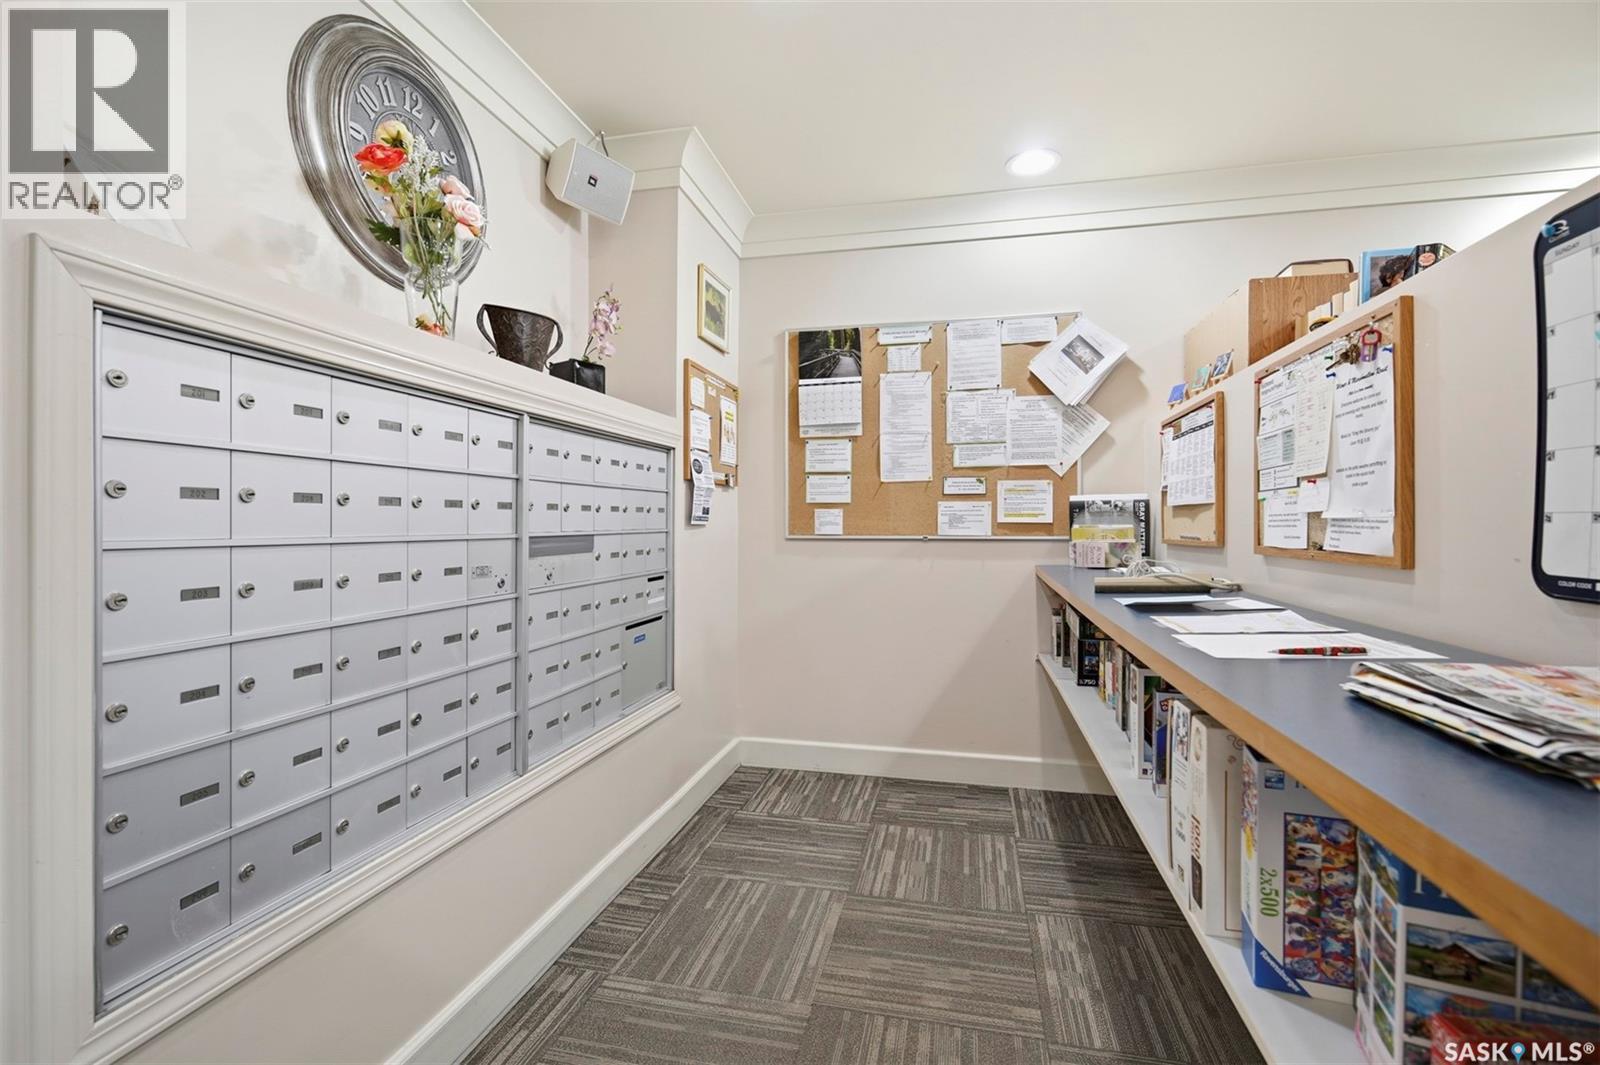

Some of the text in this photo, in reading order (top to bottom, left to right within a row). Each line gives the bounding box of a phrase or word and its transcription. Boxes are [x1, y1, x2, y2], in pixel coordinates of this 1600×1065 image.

[354, 83, 380, 120] 10
[376, 76, 398, 107] 11
[402, 85, 424, 119] 12
[428, 117, 441, 137] 1
[440, 150, 457, 166] 2
[1260, 867, 1280, 917] 2x500
